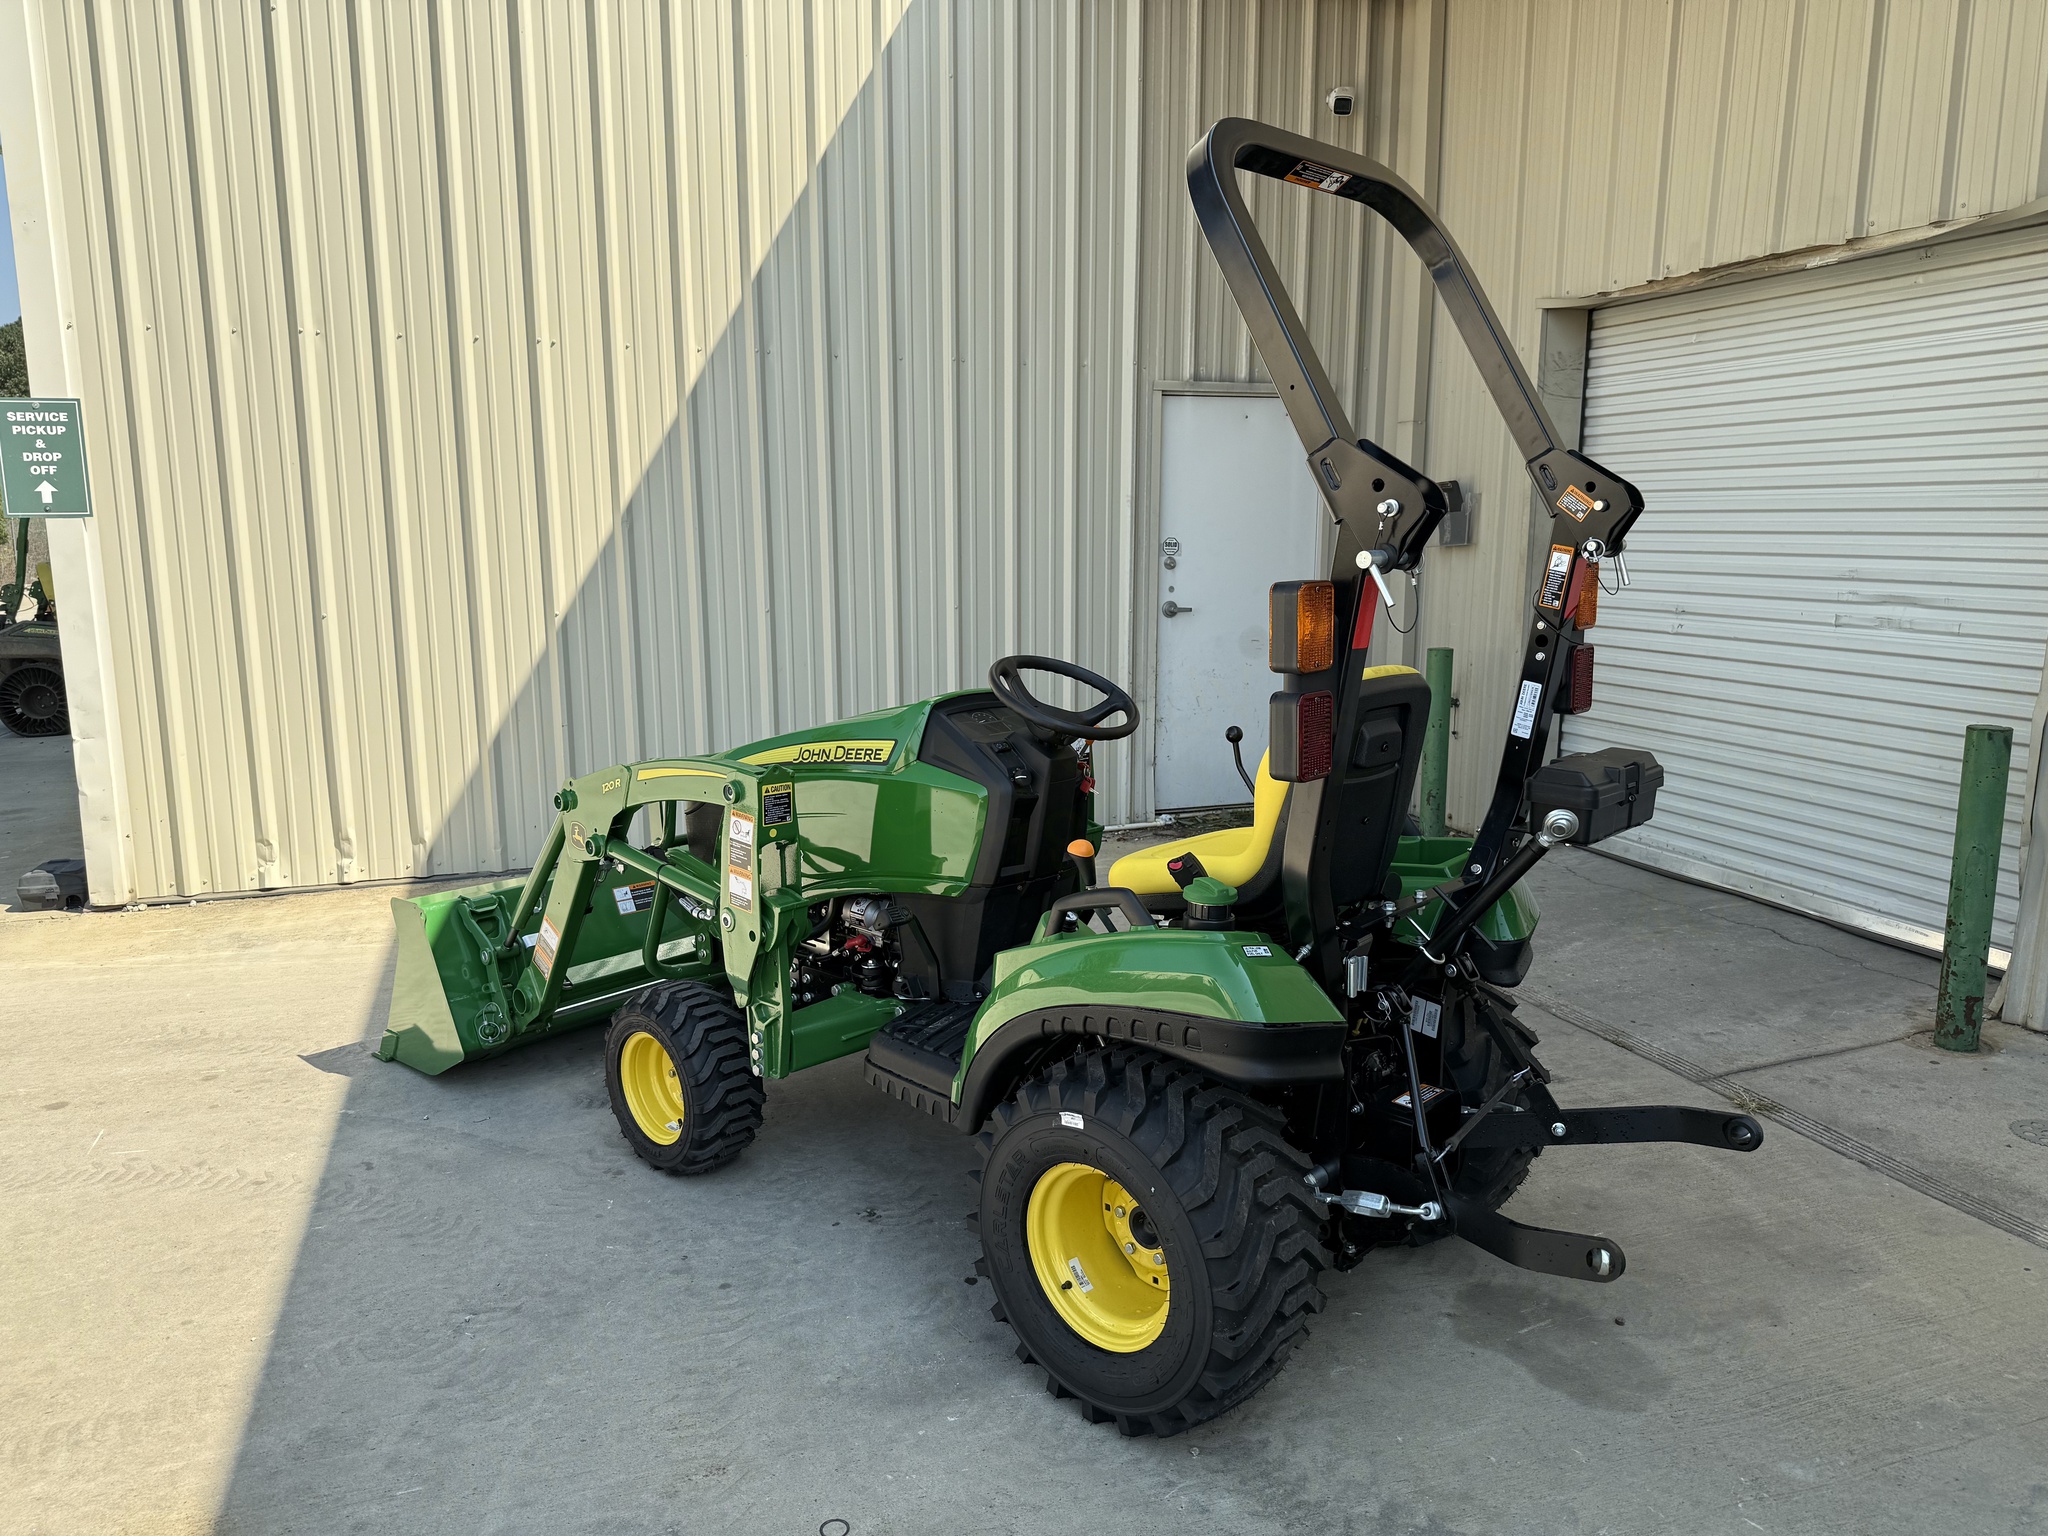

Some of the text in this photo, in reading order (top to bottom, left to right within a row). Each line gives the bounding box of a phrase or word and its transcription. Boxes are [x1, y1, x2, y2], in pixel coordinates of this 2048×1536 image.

[7, 411, 68, 421] SERVICE
[12, 425, 66, 435] PICKUP
[35, 439, 46, 448] &
[23, 452, 62, 462] DROP
[30, 465, 57, 475] OFF
[792, 746, 884, 762] JOHN DEERE
[602, 778, 621, 794] 120 R
[770, 784, 791, 793] CAUTION
[993, 1149, 1030, 1273] CARLSTAR
